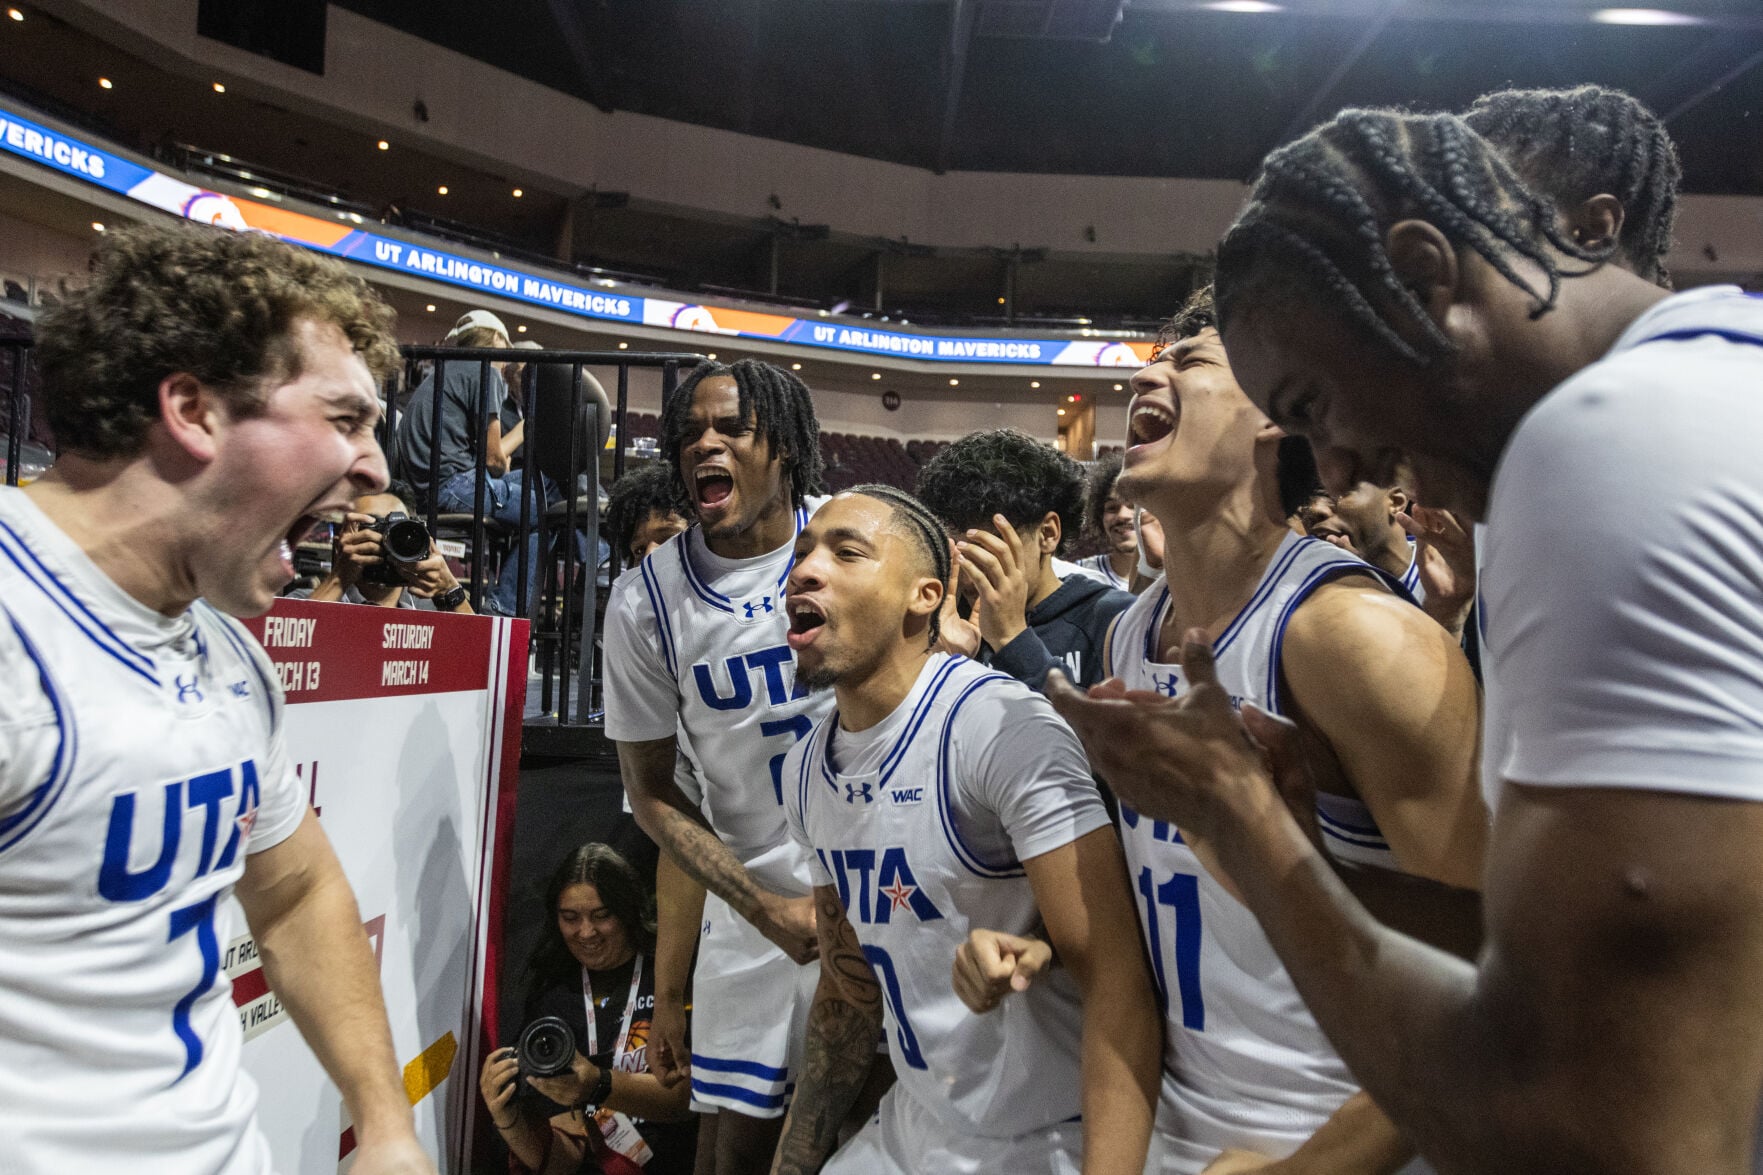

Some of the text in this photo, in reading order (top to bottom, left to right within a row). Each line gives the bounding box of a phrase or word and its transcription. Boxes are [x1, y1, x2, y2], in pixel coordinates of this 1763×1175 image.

[375, 240, 631, 317] UT ARLINGTON MAVERICKS
[813, 325, 1041, 360] UT ARLINGTON MAVERICKS
[264, 616, 317, 648] FRIDAY
[382, 623, 435, 649] SATURDAY
[274, 661, 304, 692] RCH
[306, 661, 321, 691] 13
[381, 660, 430, 686] MARCH 14
[891, 787, 923, 803] WAC
[98, 759, 260, 903] UTA
[1138, 865, 1205, 1032] 11
